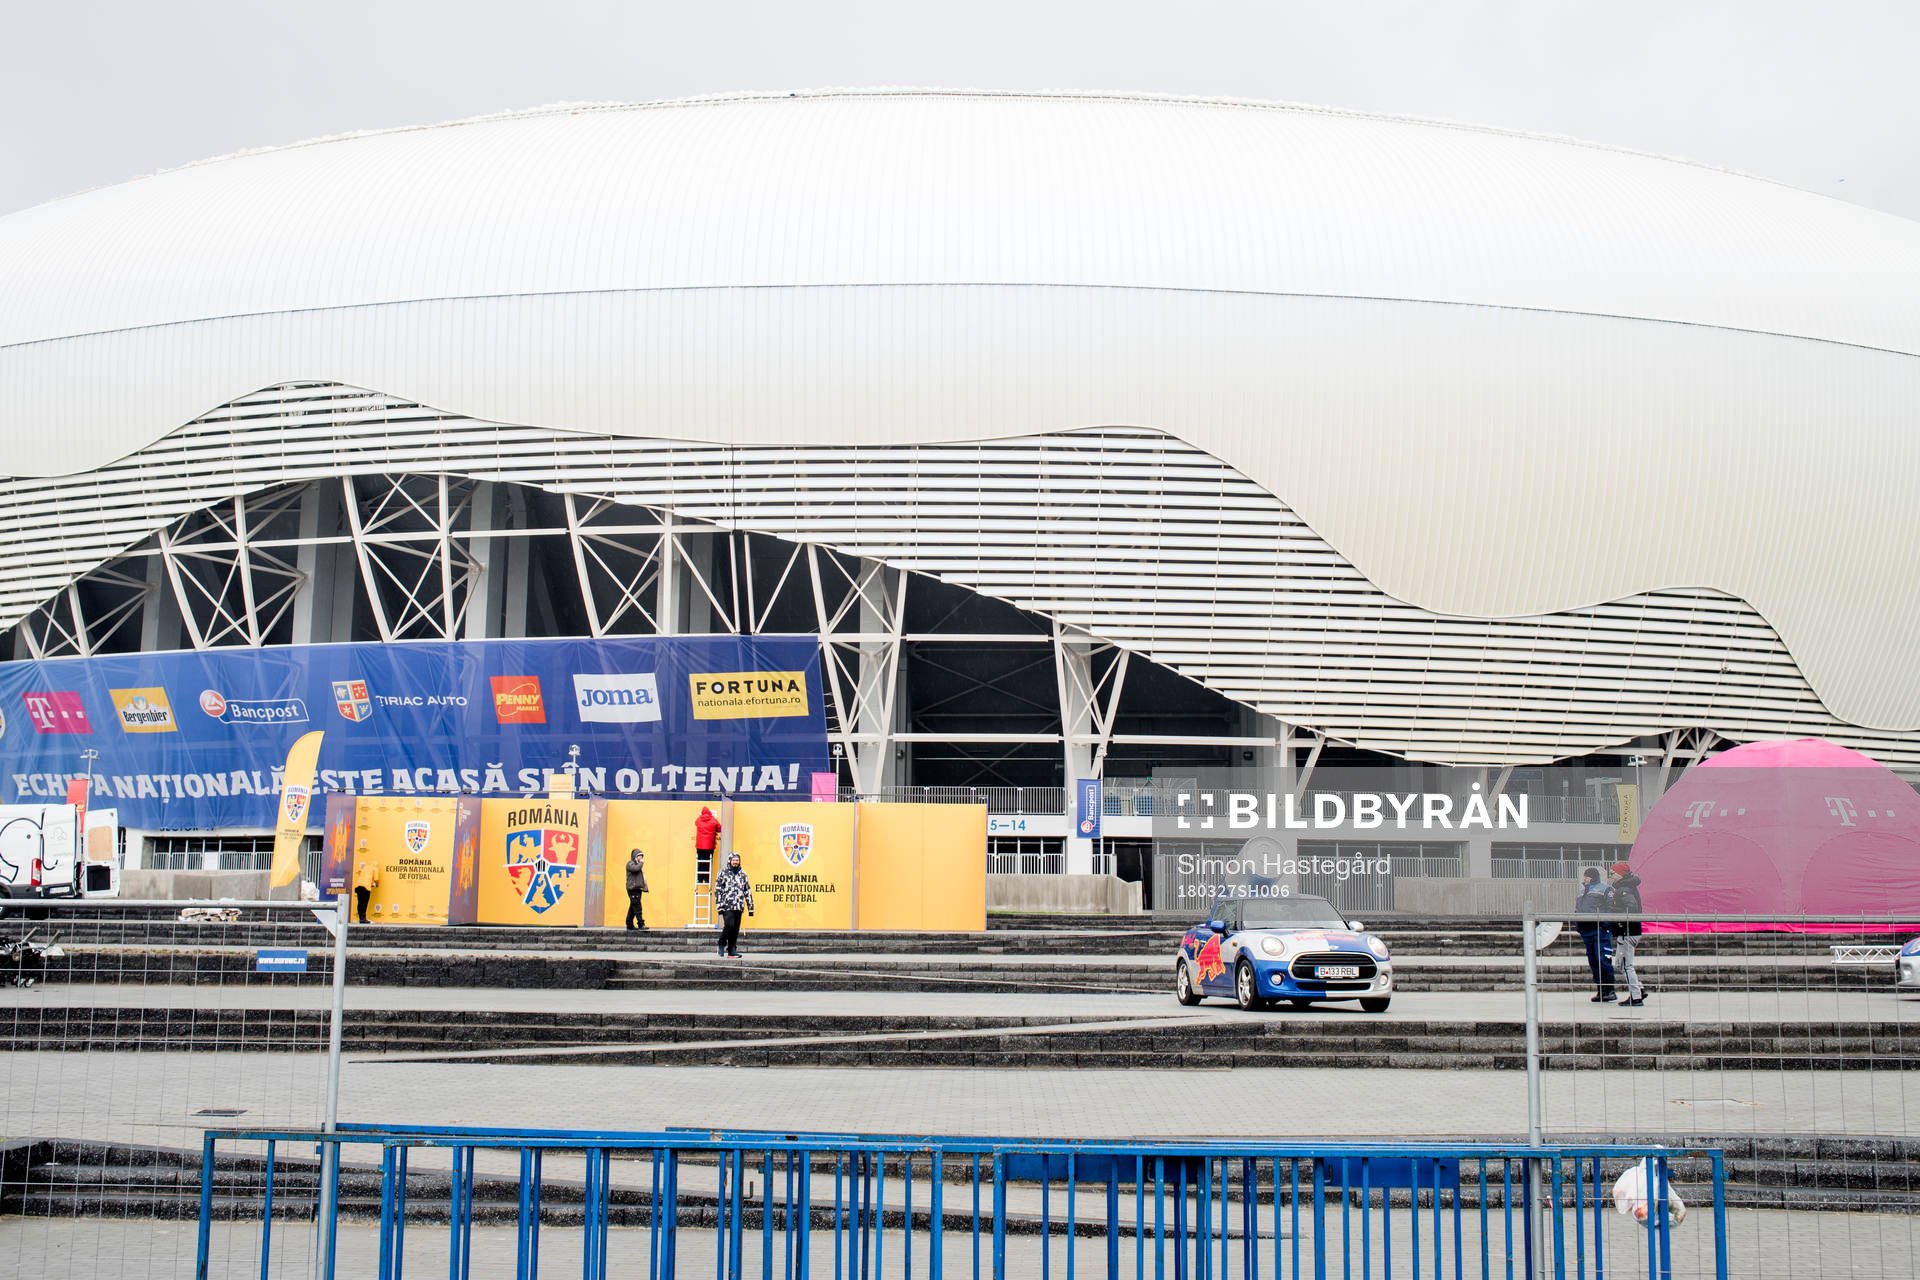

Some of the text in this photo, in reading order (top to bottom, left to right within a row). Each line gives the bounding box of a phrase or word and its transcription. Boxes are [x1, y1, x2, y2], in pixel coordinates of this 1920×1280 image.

[696, 679, 800, 695] FORTUNA
[426, 695, 468, 706] AUTO
[496, 693, 540, 705] PENNY
[697, 696, 801, 707] nationala.efortuna.ro
[122, 709, 169, 725] Bergenbier
[230, 703, 300, 722] Bancpost
[392, 762, 510, 794] ACASĂ
[615, 763, 800, 794] OLTENIA!
[1087, 788, 1096, 821] Bancpost
[507, 804, 579, 828] ROMÂNIA
[385, 865, 408, 873] ECHIPA
[408, 873, 431, 881] FOTBAL
[773, 873, 818, 883] ROMÂNIA
[755, 884, 785, 893] ECHIPA
[773, 894, 817, 903] DE FOTBAL
[1341, 968, 1357, 976] RBL
